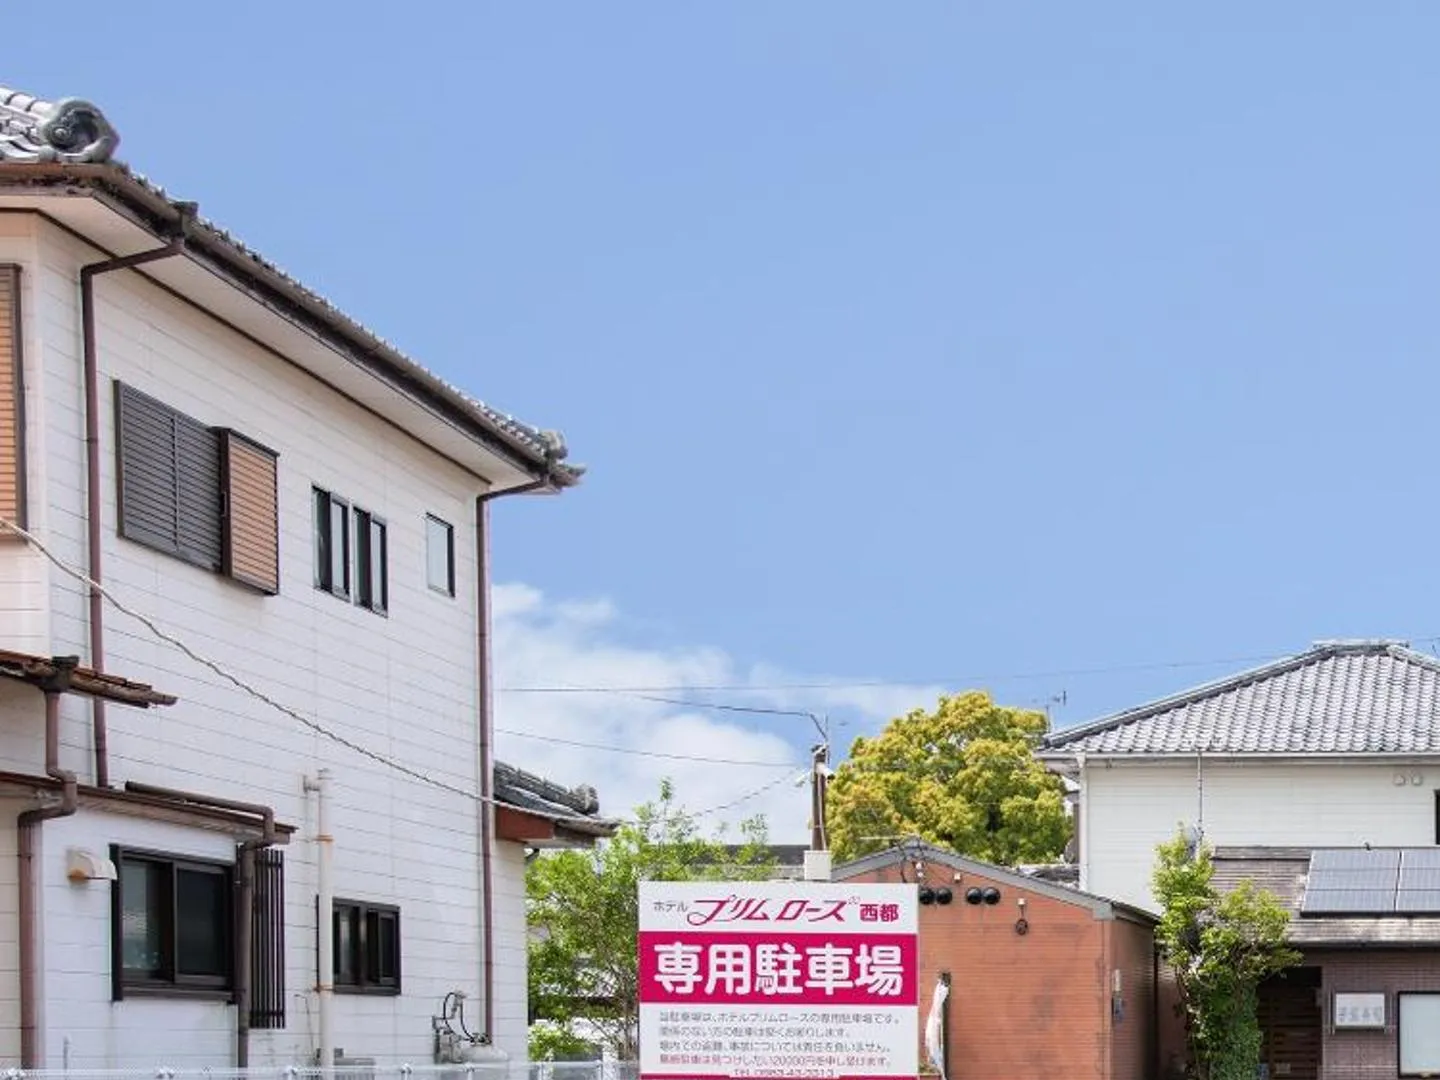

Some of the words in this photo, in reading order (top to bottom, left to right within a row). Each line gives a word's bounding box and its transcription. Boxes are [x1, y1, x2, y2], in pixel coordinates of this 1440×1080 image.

[654, 901, 688, 912] ホテル
[860, 903, 899, 922] 西都
[653, 941, 904, 996] 専用駐車場
